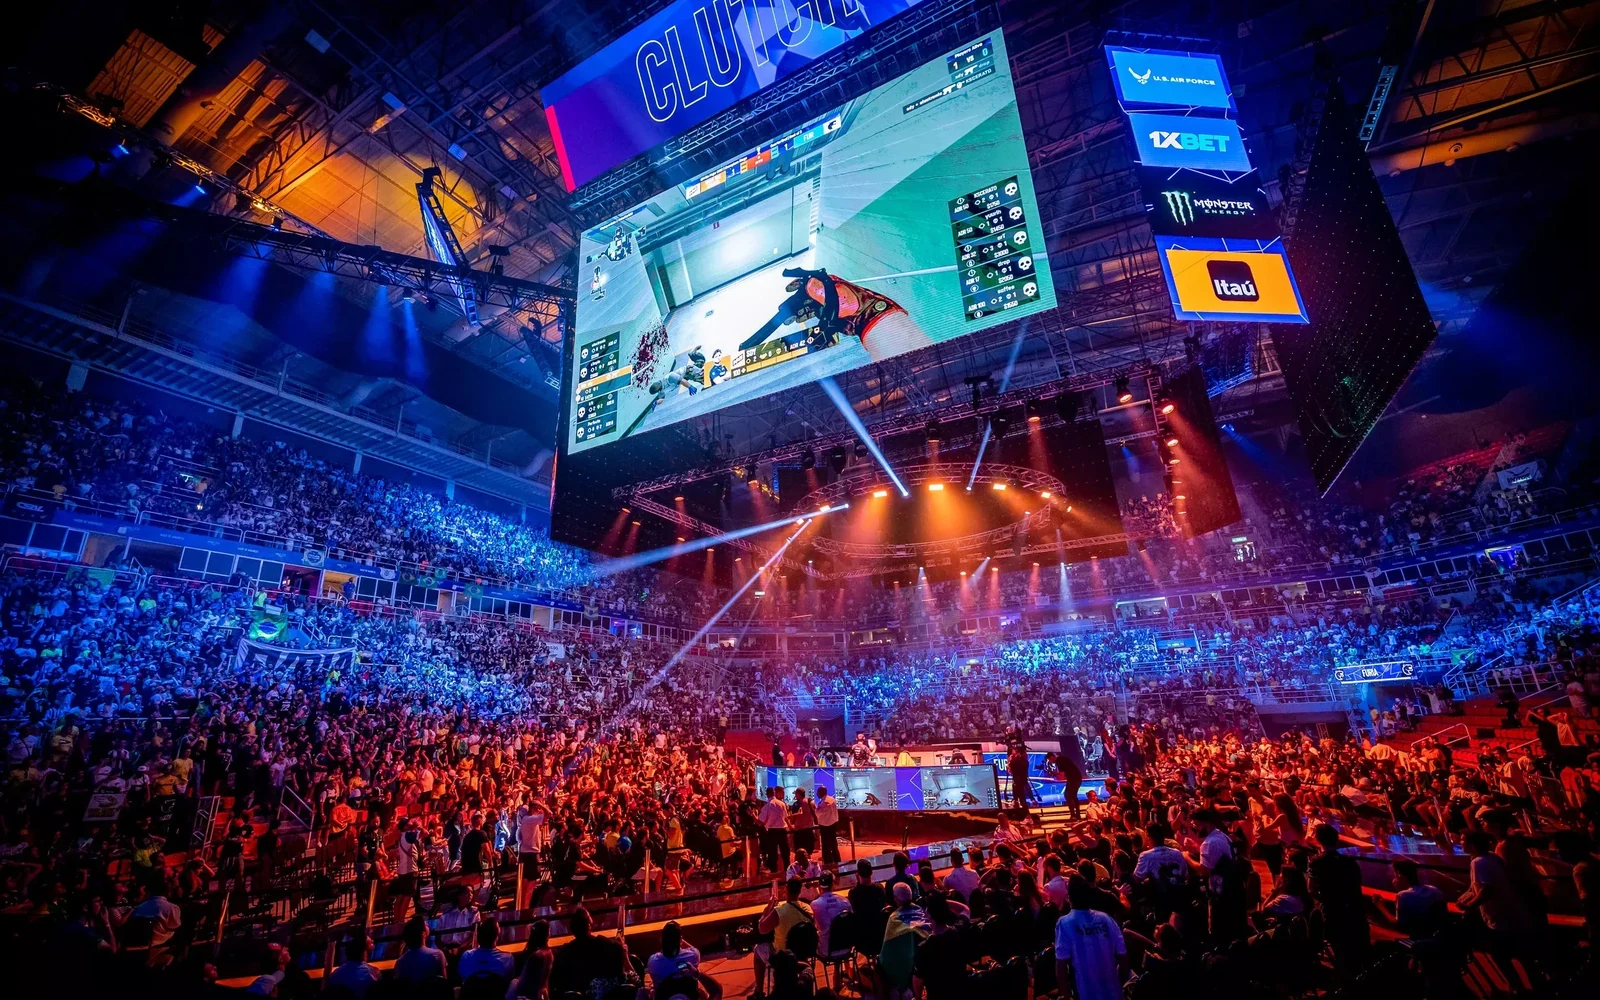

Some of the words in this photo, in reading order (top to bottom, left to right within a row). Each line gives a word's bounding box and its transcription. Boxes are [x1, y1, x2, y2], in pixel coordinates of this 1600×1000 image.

[636, 0, 859, 122] CLUTC
[953, 62, 958, 70] 1
[982, 48, 988, 56] 0
[966, 68, 992, 84] KSCERATO
[1149, 130, 1230, 152] 1XBET
[1194, 199, 1254, 211] MONSTER
[1214, 279, 1256, 296] Itaú
[1361, 668, 1379, 677] FURIA
